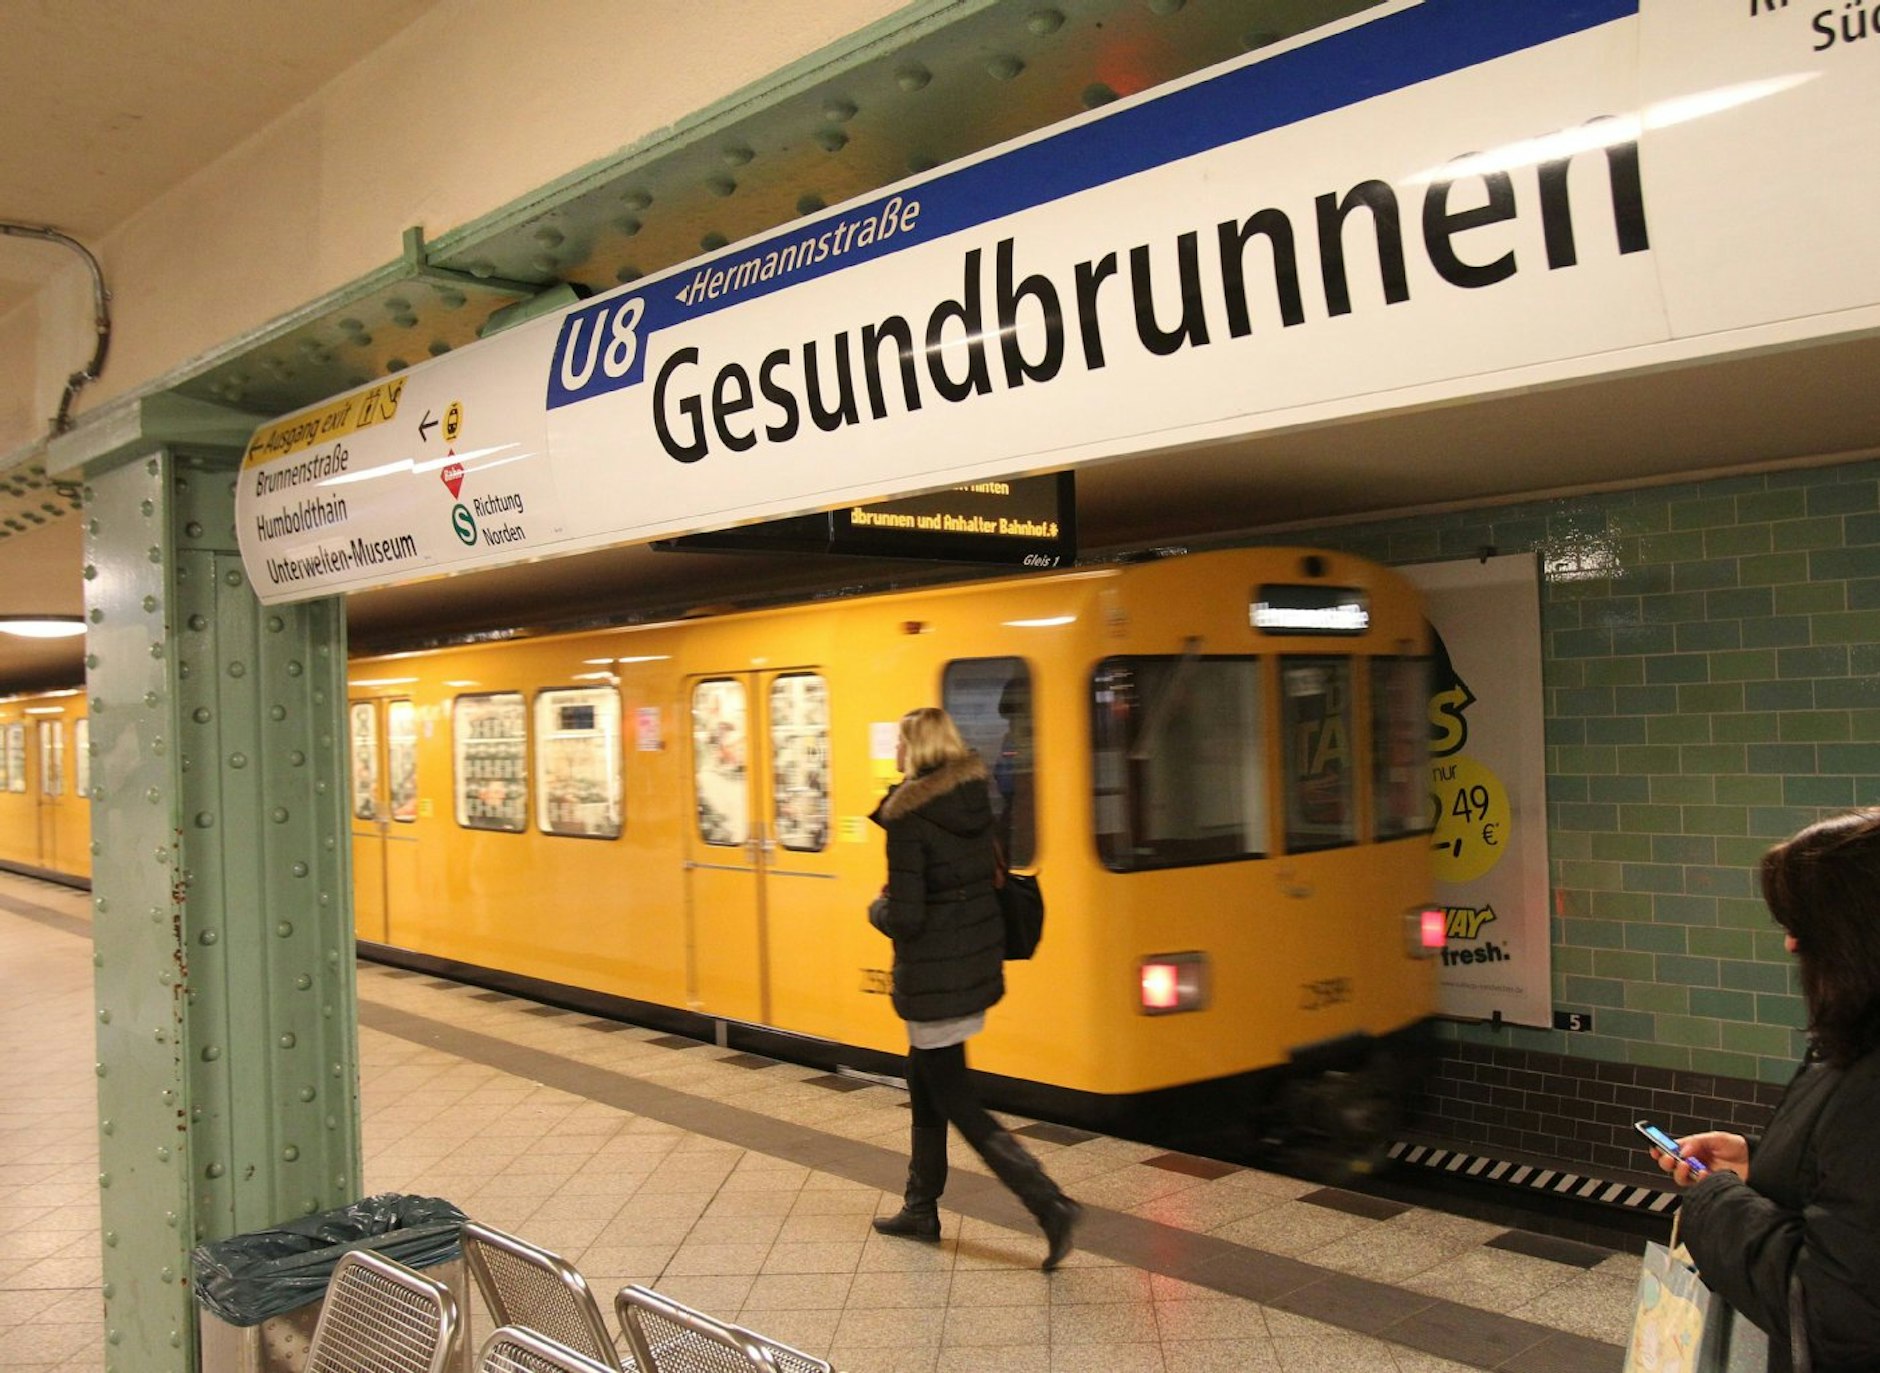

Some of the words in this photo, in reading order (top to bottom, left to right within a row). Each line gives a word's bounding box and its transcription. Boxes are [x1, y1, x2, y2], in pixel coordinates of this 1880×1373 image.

[687, 196, 921, 307] Hermannstraße
[652, 115, 1650, 464] Gesundbrunnen
[560, 296, 646, 392] U8
[265, 418, 320, 455] Ausgang
[321, 402, 352, 434] exit
[256, 443, 349, 498] Brunnenstraße
[256, 493, 348, 542] Humboldthain
[472, 492, 524, 517] Richtung
[917, 514, 942, 531] und
[943, 513, 998, 534] Anhalter
[266, 533, 418, 585] Unterwelten-Museum
[482, 522, 527, 547] Norden
[1023, 553, 1051, 568] Gleis
[1051, 555, 1061, 568] 1
[1432, 764, 1457, 783] nur
[1569, 1014, 1581, 1031] 5
